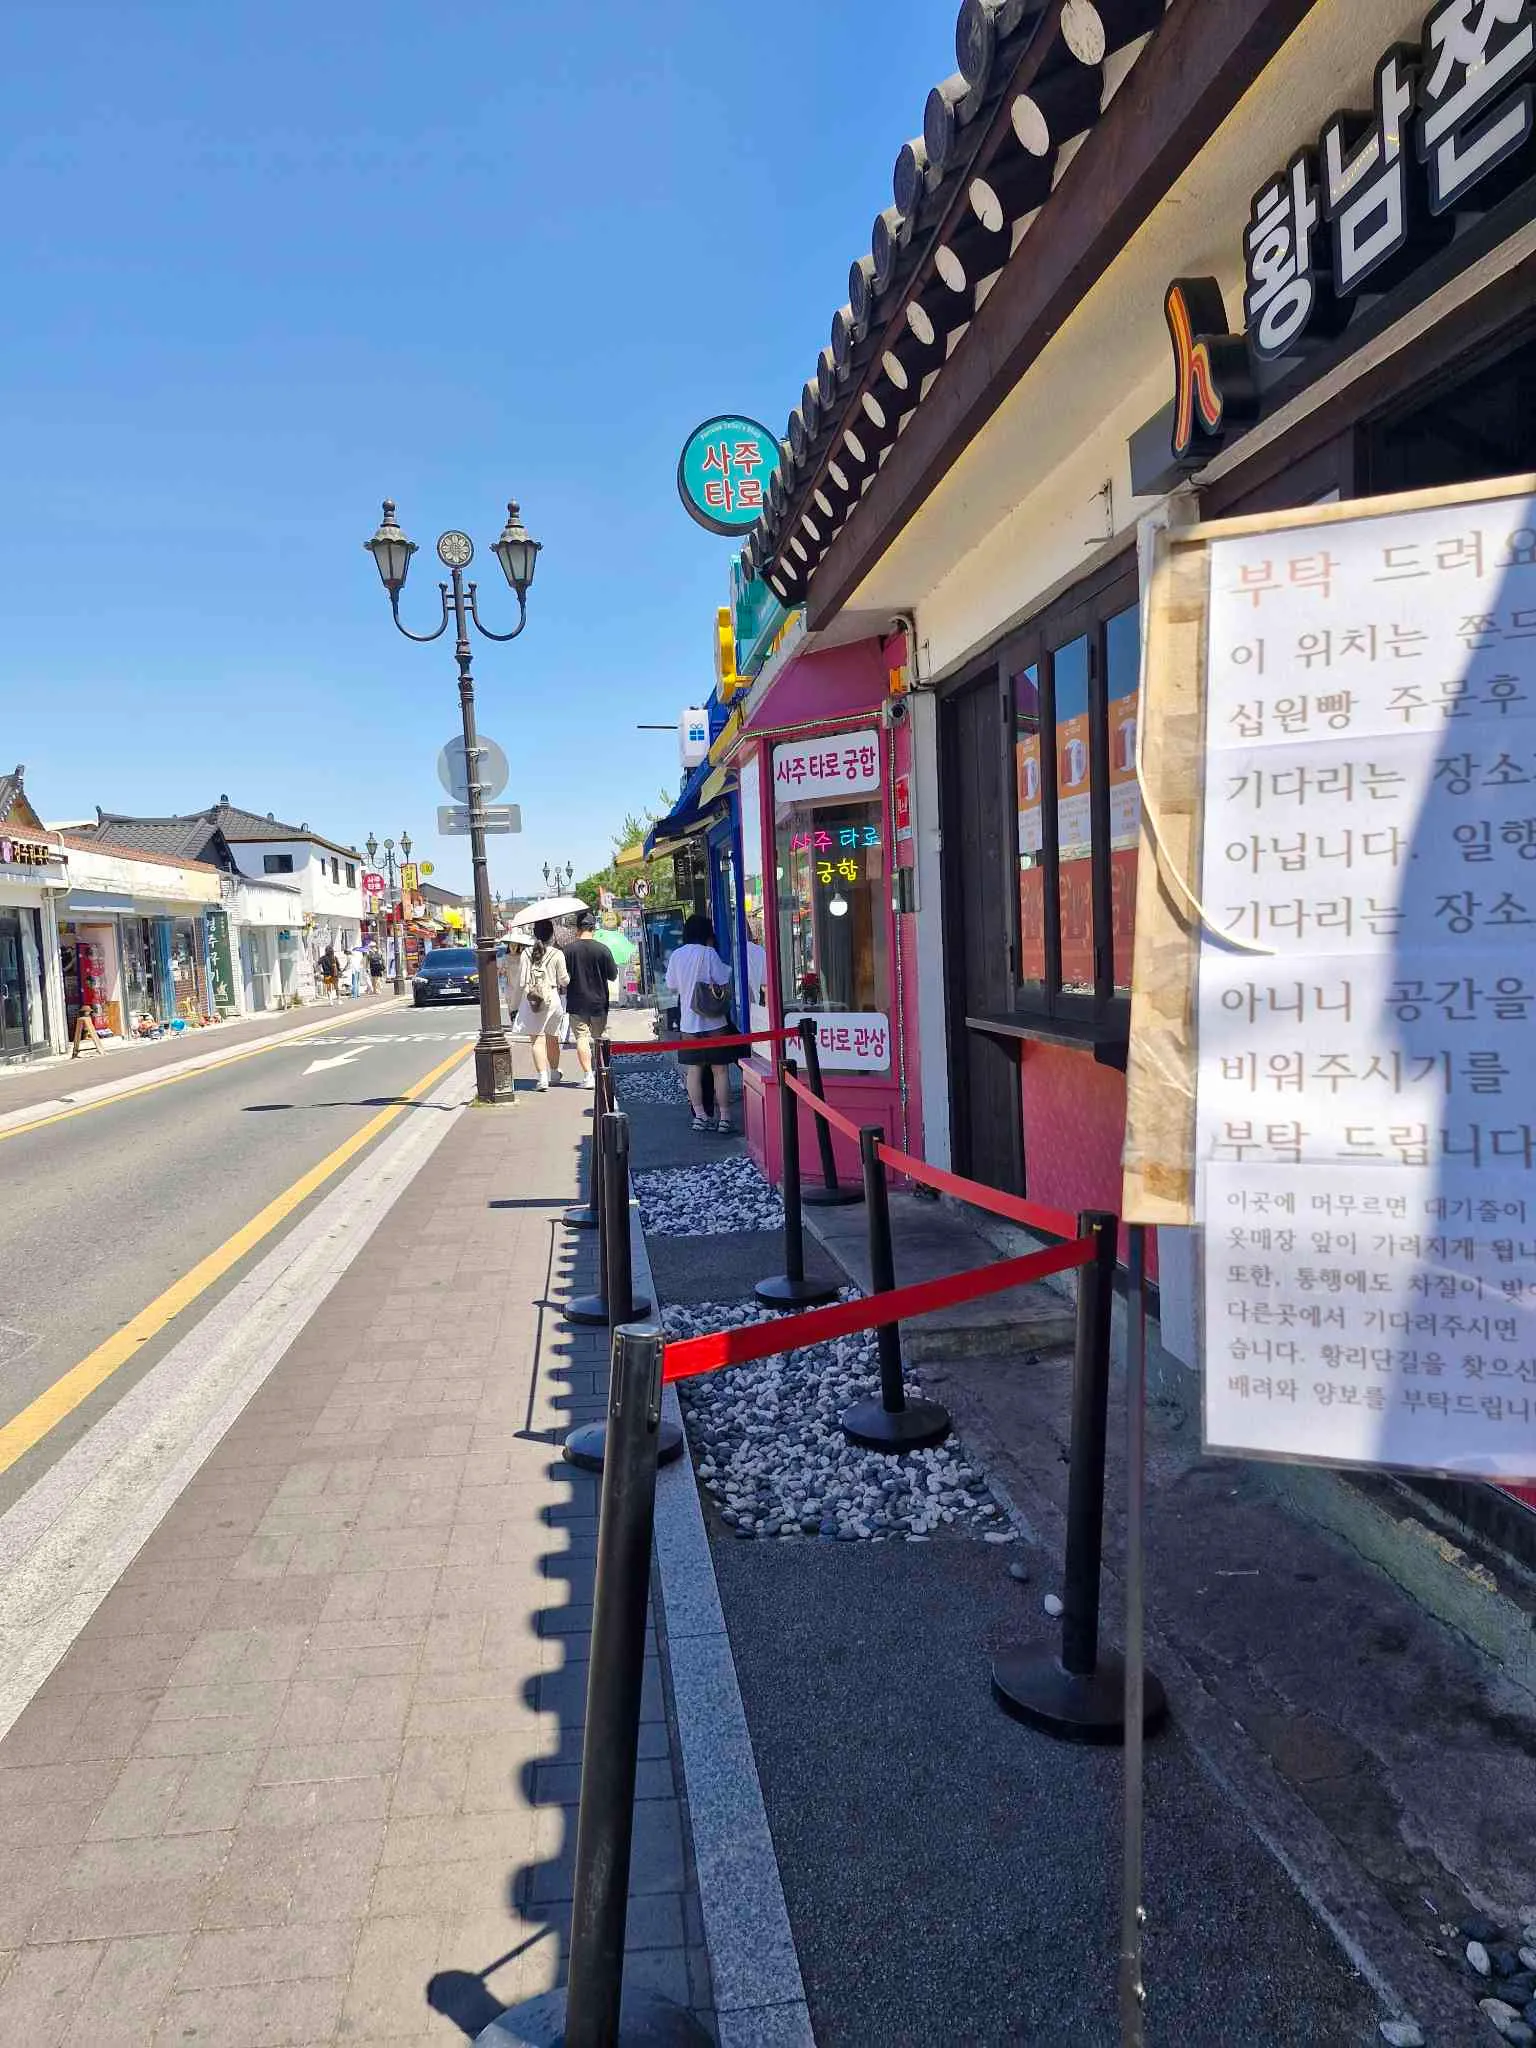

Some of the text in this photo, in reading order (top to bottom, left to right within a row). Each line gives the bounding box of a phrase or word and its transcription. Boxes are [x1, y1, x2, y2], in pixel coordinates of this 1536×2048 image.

[702, 441, 763, 476] 사주
[704, 478, 763, 513] 타로
[1229, 528, 1536, 608] 부탁 드려요
[1230, 638, 1265, 675] 이
[1295, 624, 1428, 669] 위치는
[1228, 673, 1527, 738] 십원빵 주문후
[777, 746, 876, 784] 사주 타로 궁합
[1228, 753, 1536, 808] 기다리는 장소
[791, 827, 881, 853] 사주 타로
[1225, 819, 1536, 874] 아닙니다. 일행
[816, 858, 858, 883] 궁합
[1224, 897, 1406, 940] 기다리는
[1221, 976, 1535, 1024] 아니니 공간을
[820, 1028, 851, 1052] 타로
[854, 1028, 886, 1058] 관상
[1221, 1049, 1510, 1096] 비워주시기를
[1216, 1119, 1536, 1169] 부탁 드립니다
[1227, 1190, 1526, 1224] 이곳에 머무르면 대기줄이
[1226, 1227, 1296, 1252] 옷매장
[1311, 1230, 1356, 1255] 앞이
[1372, 1233, 1475, 1262] 가려지게
[1296, 1267, 1393, 1294] 통행에도
[1408, 1273, 1483, 1301] 차질이
[1227, 1299, 1519, 1343] 다른곳에서 기다려주시면
[1227, 1337, 1536, 1384] 습니다. 황리단길을 찾으신
[1228, 1375, 1536, 1424] 배려와 양보를 부탁드립니
